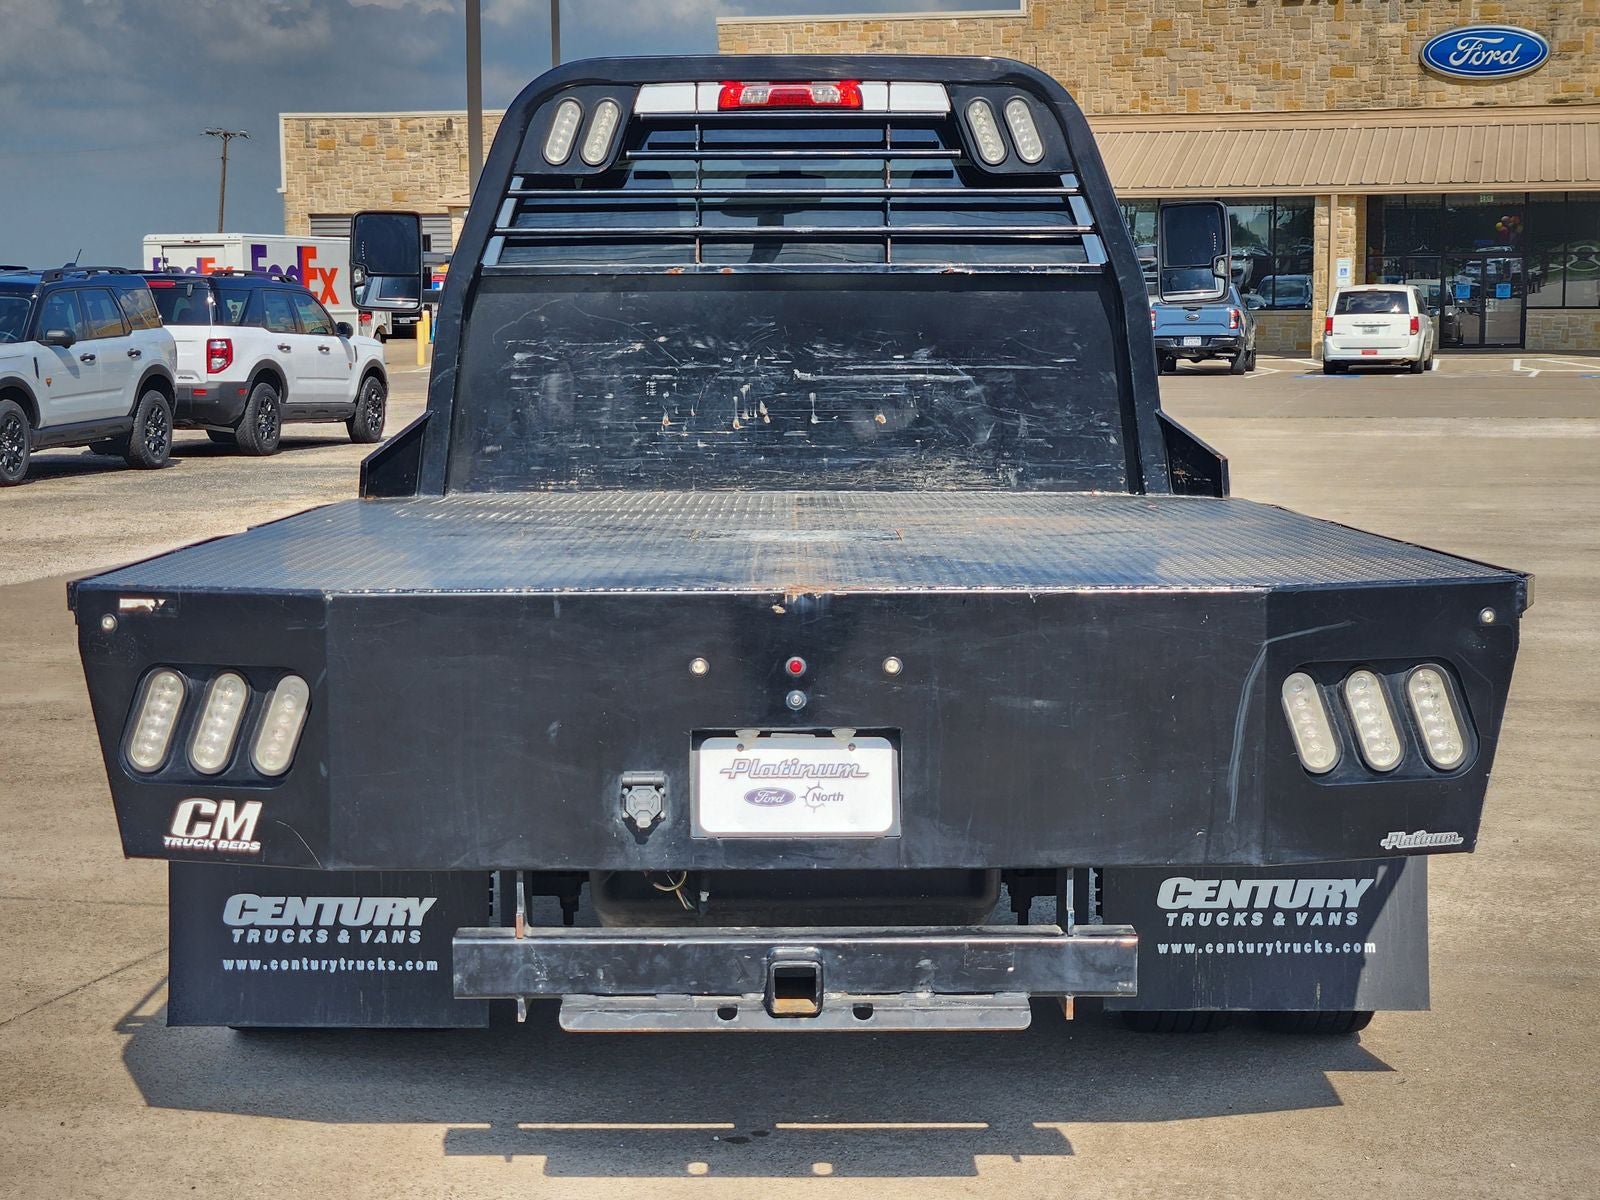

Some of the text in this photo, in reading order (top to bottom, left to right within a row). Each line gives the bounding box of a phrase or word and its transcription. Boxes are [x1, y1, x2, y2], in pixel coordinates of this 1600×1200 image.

[1449, 36, 1522, 65] Ford
[720, 758, 869, 779] Platinum
[754, 791, 786, 803] Ford
[811, 791, 844, 802] North
[171, 797, 262, 842] CM
[163, 836, 262, 852] TRUCK BEDS
[1380, 830, 1464, 849] Platinum
[1156, 876, 1374, 910] CENTURY
[222, 893, 438, 927] CENTURY
[1166, 911, 1359, 926] TRUCKS & VANS
[232, 928, 422, 944] TRUCKS & VANS
[1157, 939, 1377, 957] www.centurytrucks.com
[222, 957, 439, 974] www.centurytrucks.com
